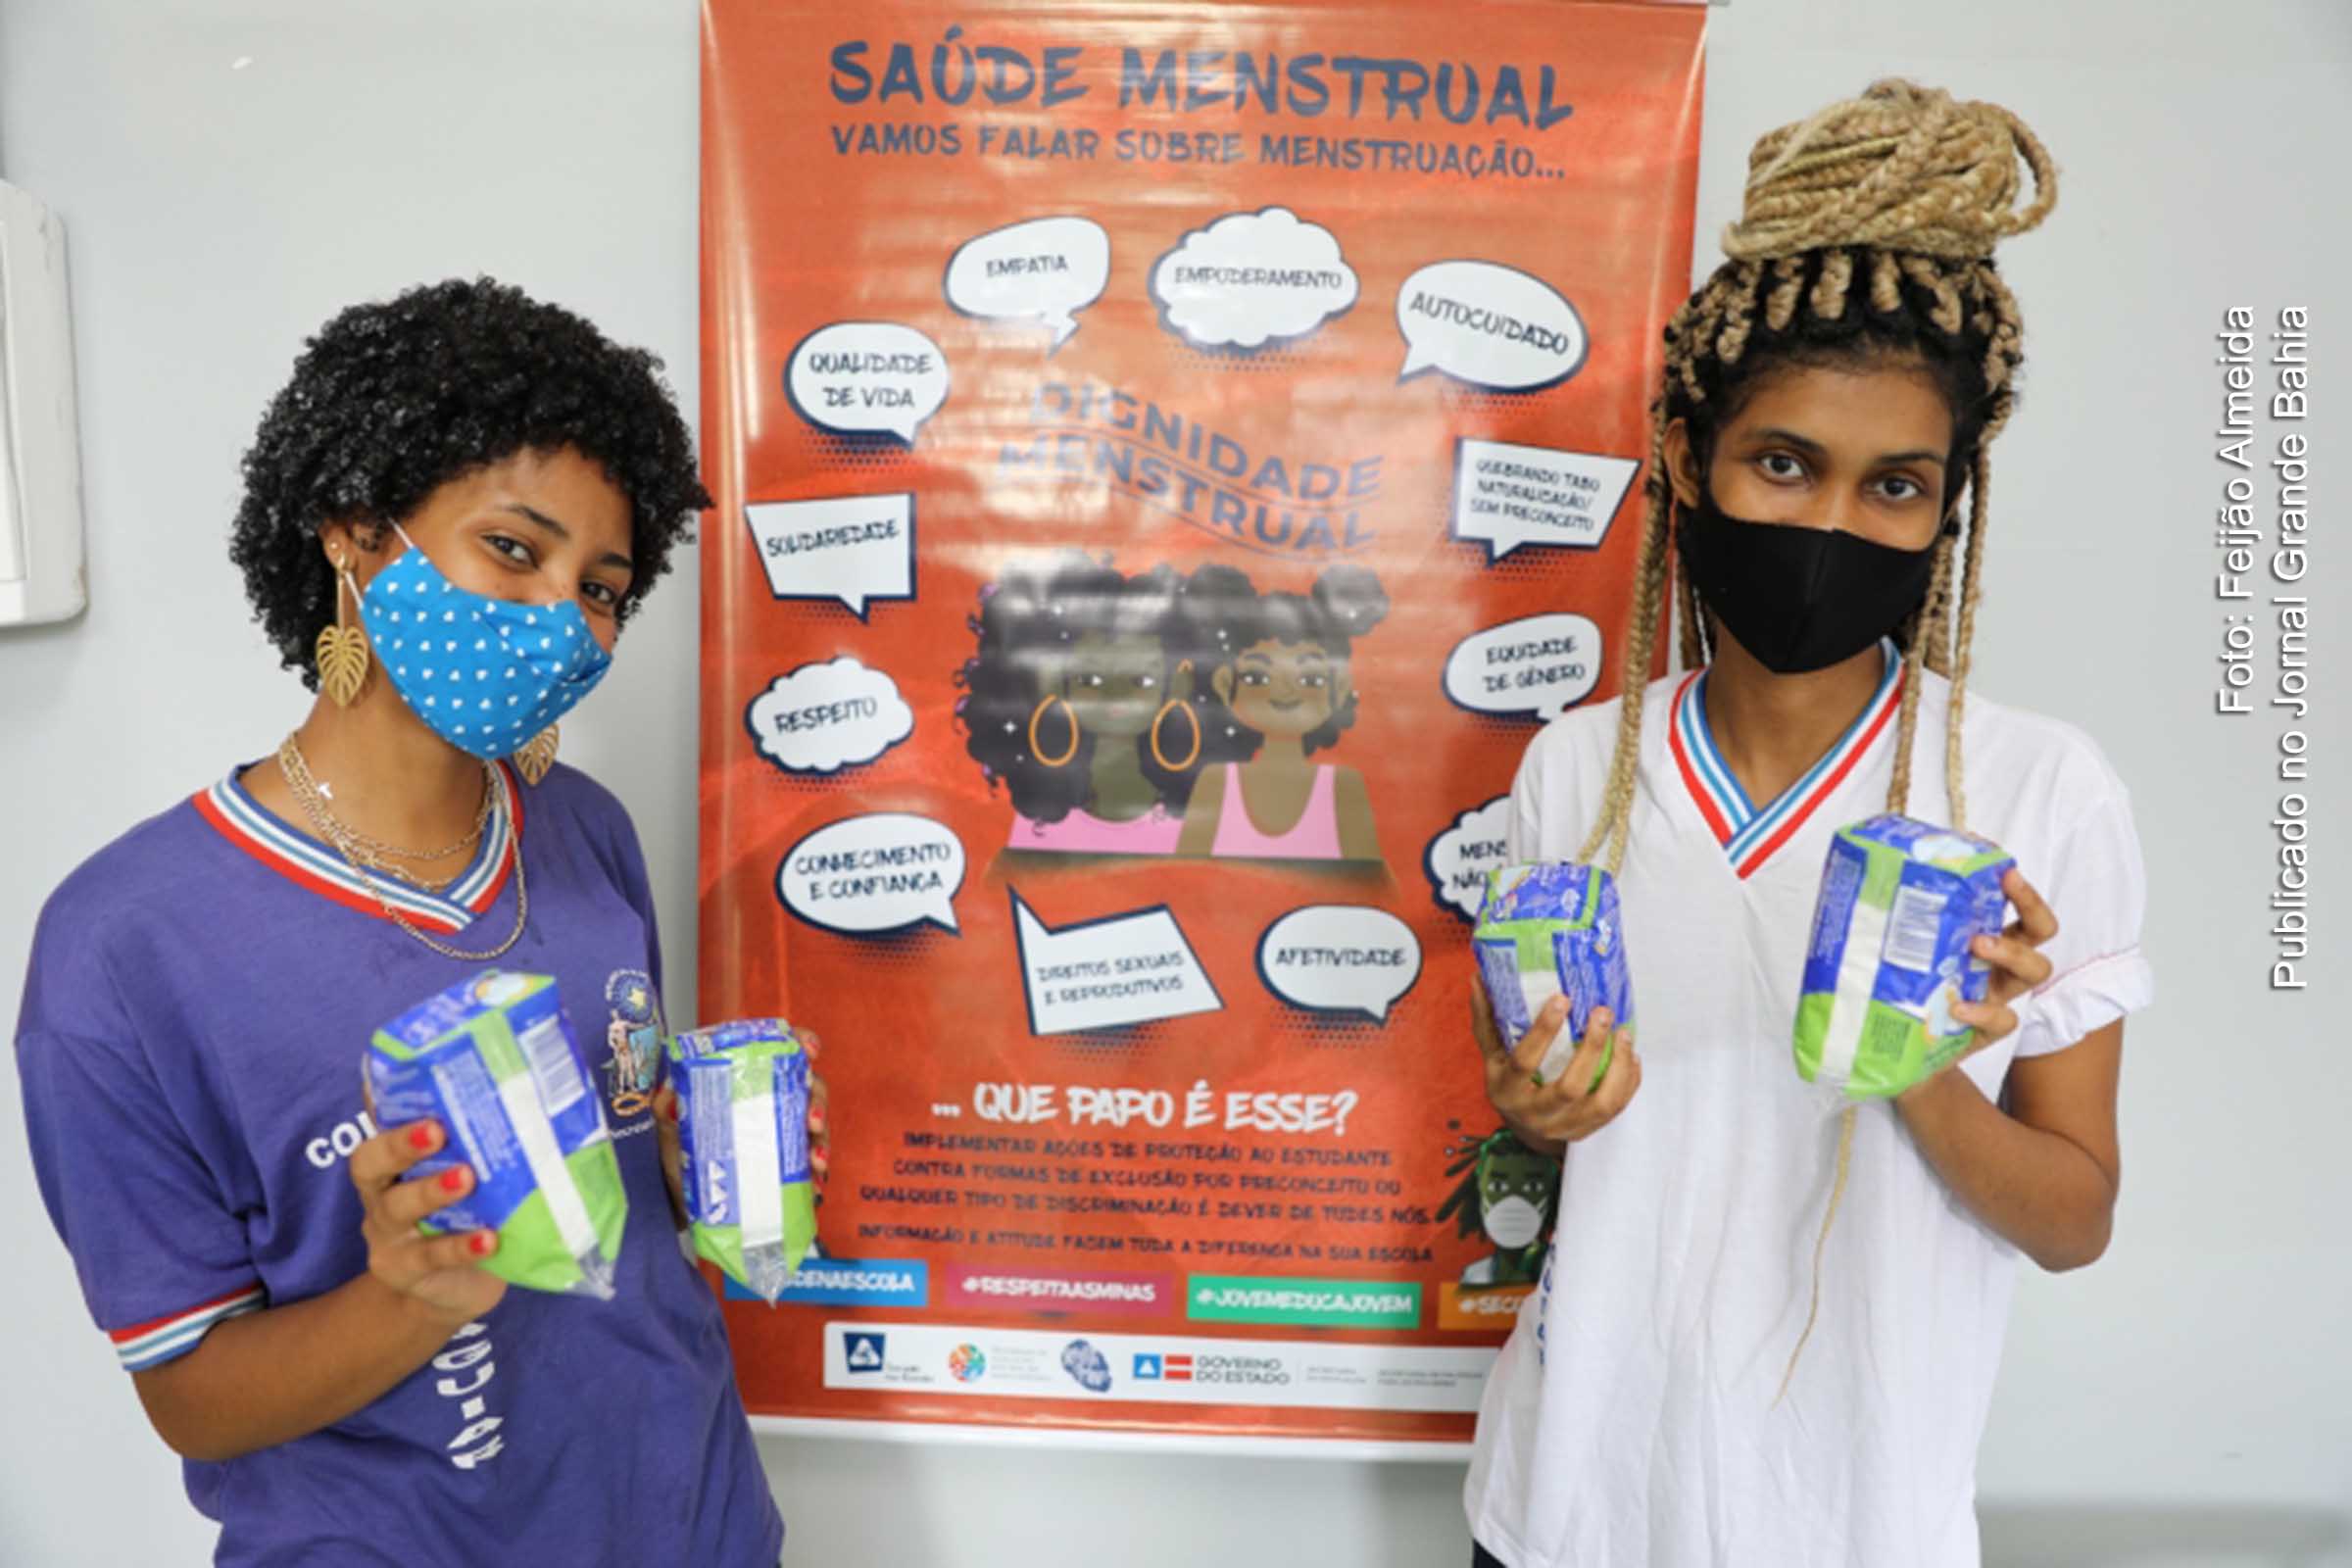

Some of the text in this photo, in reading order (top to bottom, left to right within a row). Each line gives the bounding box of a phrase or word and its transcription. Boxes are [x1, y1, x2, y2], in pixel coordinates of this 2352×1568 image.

[830, 25, 1573, 131] SAÚDE MENSTRUAL
[832, 124, 961, 155] VAMOS
[979, 126, 1099, 160] FALAR
[1115, 130, 1243, 164] SOBRE
[986, 255, 1069, 277] EMPATIA
[1175, 267, 1342, 289] EMPODERAMENTO
[1409, 292, 1568, 355] AUTOCUIDADO
[809, 353, 933, 373] QUALIDADE
[823, 387, 914, 408] DE VIDA
[1031, 382, 1384, 501] DIGNIDADE
[1477, 458, 1559, 485] QUEBRANDO
[997, 433, 1378, 551] MENSTRUAL
[1503, 502, 1594, 531] PRECONCEITO
[766, 519, 900, 557] SOLIDARIEDADE
[1486, 635, 1577, 664] EQUIDADE
[1483, 662, 1586, 692] DE GÊNERO
[774, 697, 877, 734] RESPEITO
[795, 842, 951, 875] CONHECIMENTO
[810, 870, 944, 901] E CONFIANÇA
[1036, 950, 1184, 982] DIREITOS SEXUAIS
[1275, 948, 1405, 967] AFETIVIDADE
[1061, 975, 1184, 1004] REPRODUTIVOS
[973, 1081, 1059, 1123] QUE
[1066, 1085, 1174, 1127] PAPO
[1184, 1079, 1216, 1128] É
[1224, 1089, 1358, 1137] ESSE?
[904, 1131, 1035, 1154] IMPLEMENTAR
[1109, 1143, 1137, 1158] DE
[1145, 1141, 1242, 1163] PROTEÇÃO
[1250, 1146, 1275, 1162] AO
[1281, 1148, 1392, 1166] ESTUDANTE
[893, 1159, 965, 1177] CONTRA
[971, 1164, 1049, 1183] FORMAS
[1056, 1167, 1082, 1183] DE
[1089, 1168, 1187, 1188] EXCLUSÃO
[1240, 1175, 1369, 1195] PRECONCEITO
[1375, 1179, 1401, 1196] OU
[859, 1183, 957, 1205] QUALQUER
[963, 1190, 1005, 1207] TIPO
[1012, 1194, 1039, 1210] DE
[1218, 1201, 1281, 1219] DEVER
[1289, 1203, 1314, 1220] DE
[858, 1223, 963, 1245] INFORMAÇÃO
[1368, 1247, 1434, 1263] ESCOLA
[1198, 1355, 1281, 1370] GOVERNO
[1198, 1370, 1220, 1383] DO
[1224, 1371, 1291, 1386] ESTADO
